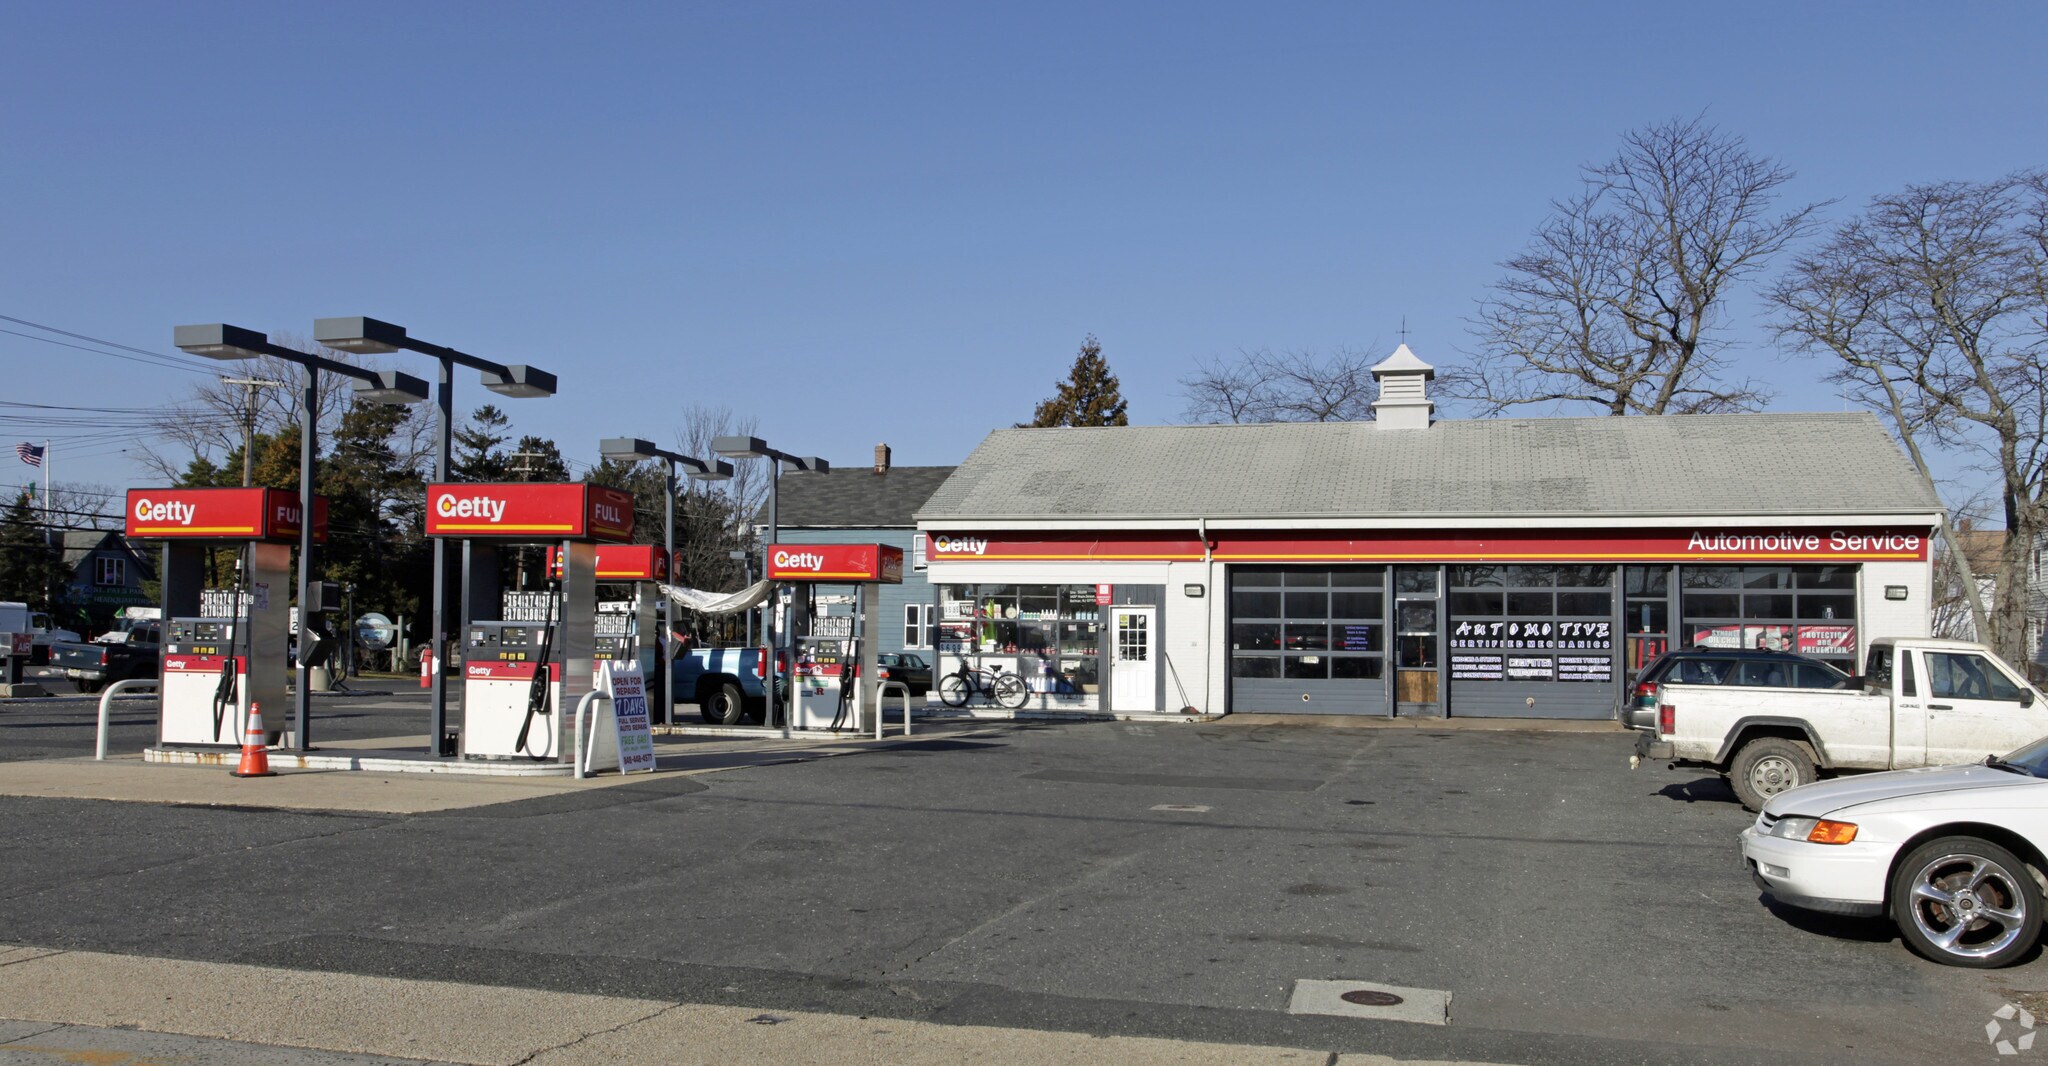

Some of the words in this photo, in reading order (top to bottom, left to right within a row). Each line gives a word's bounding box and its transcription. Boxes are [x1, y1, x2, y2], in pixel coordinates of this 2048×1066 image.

[135, 498, 195, 525] Getty
[277, 506, 300, 523] FUL
[436, 494, 506, 522] Getty
[595, 504, 620, 523] FULL
[935, 535, 988, 554] Getty
[1688, 530, 1819, 551] Automotive
[1830, 530, 1919, 551] Service
[774, 551, 823, 571] Getty
[1450, 640, 1523, 648] CERTIFIED
[1527, 640, 1610, 648] MECHANICS
[166, 660, 186, 669] Getty
[469, 666, 491, 676] Getty
[612, 677, 628, 686] OPEN
[630, 677, 641, 685] FOR
[616, 687, 640, 695] REPAIRS
[616, 699, 622, 715] 7
[623, 698, 645, 714] DAYS
